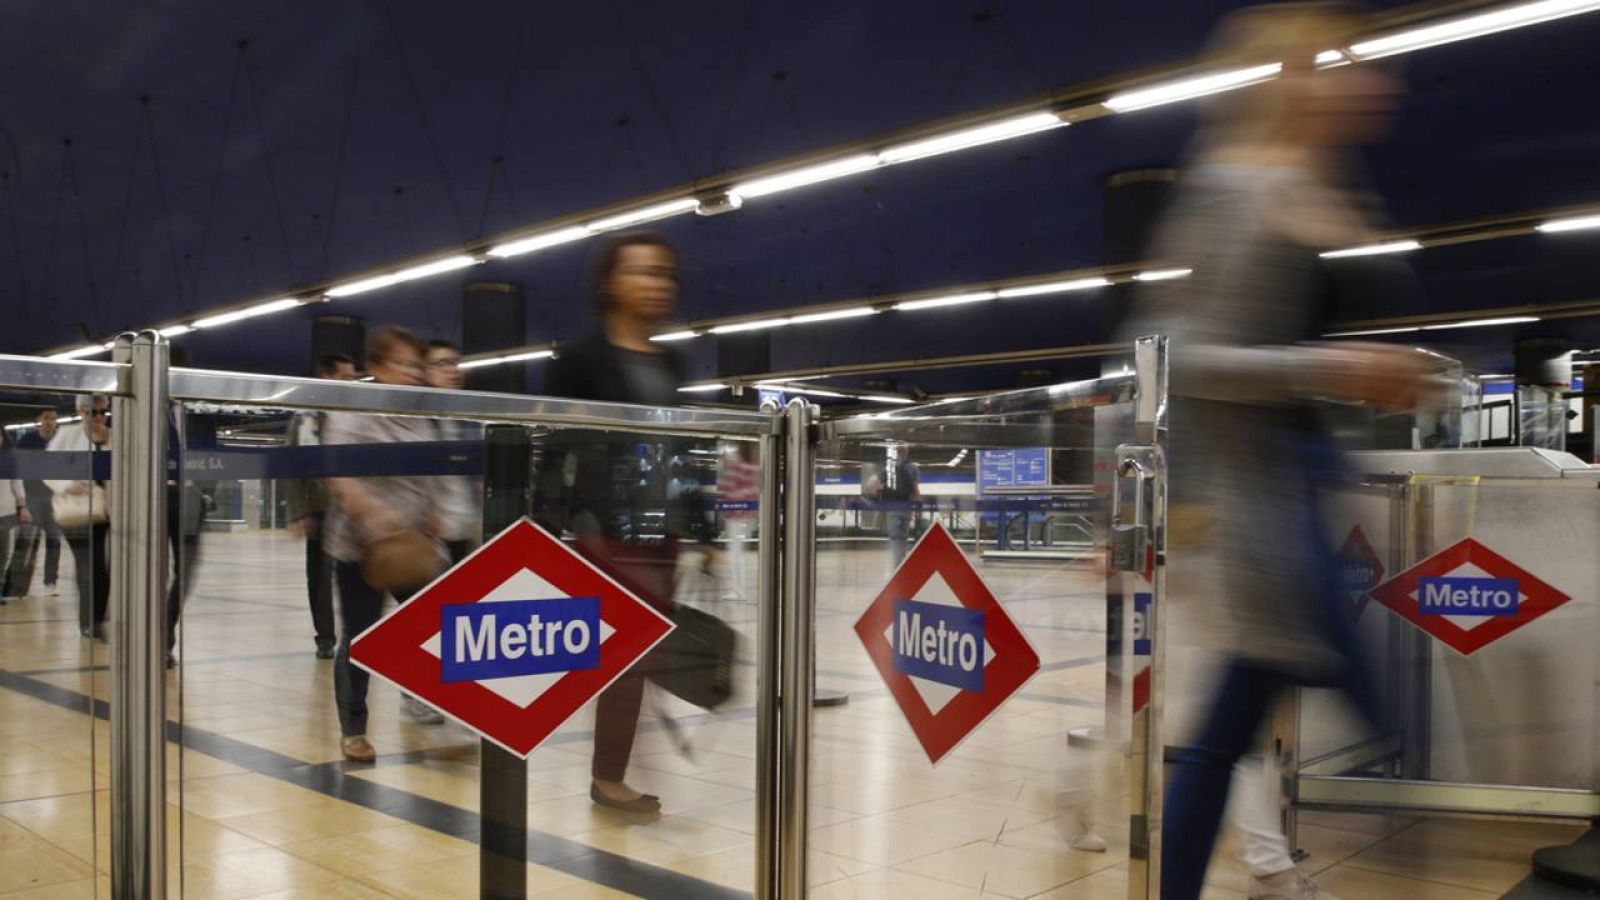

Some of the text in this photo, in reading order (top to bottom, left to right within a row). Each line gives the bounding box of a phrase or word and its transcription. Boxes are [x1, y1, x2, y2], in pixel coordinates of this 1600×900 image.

[1424, 583, 1511, 609] Metro
[454, 613, 591, 664] Metro
[898, 610, 977, 672] Metro
